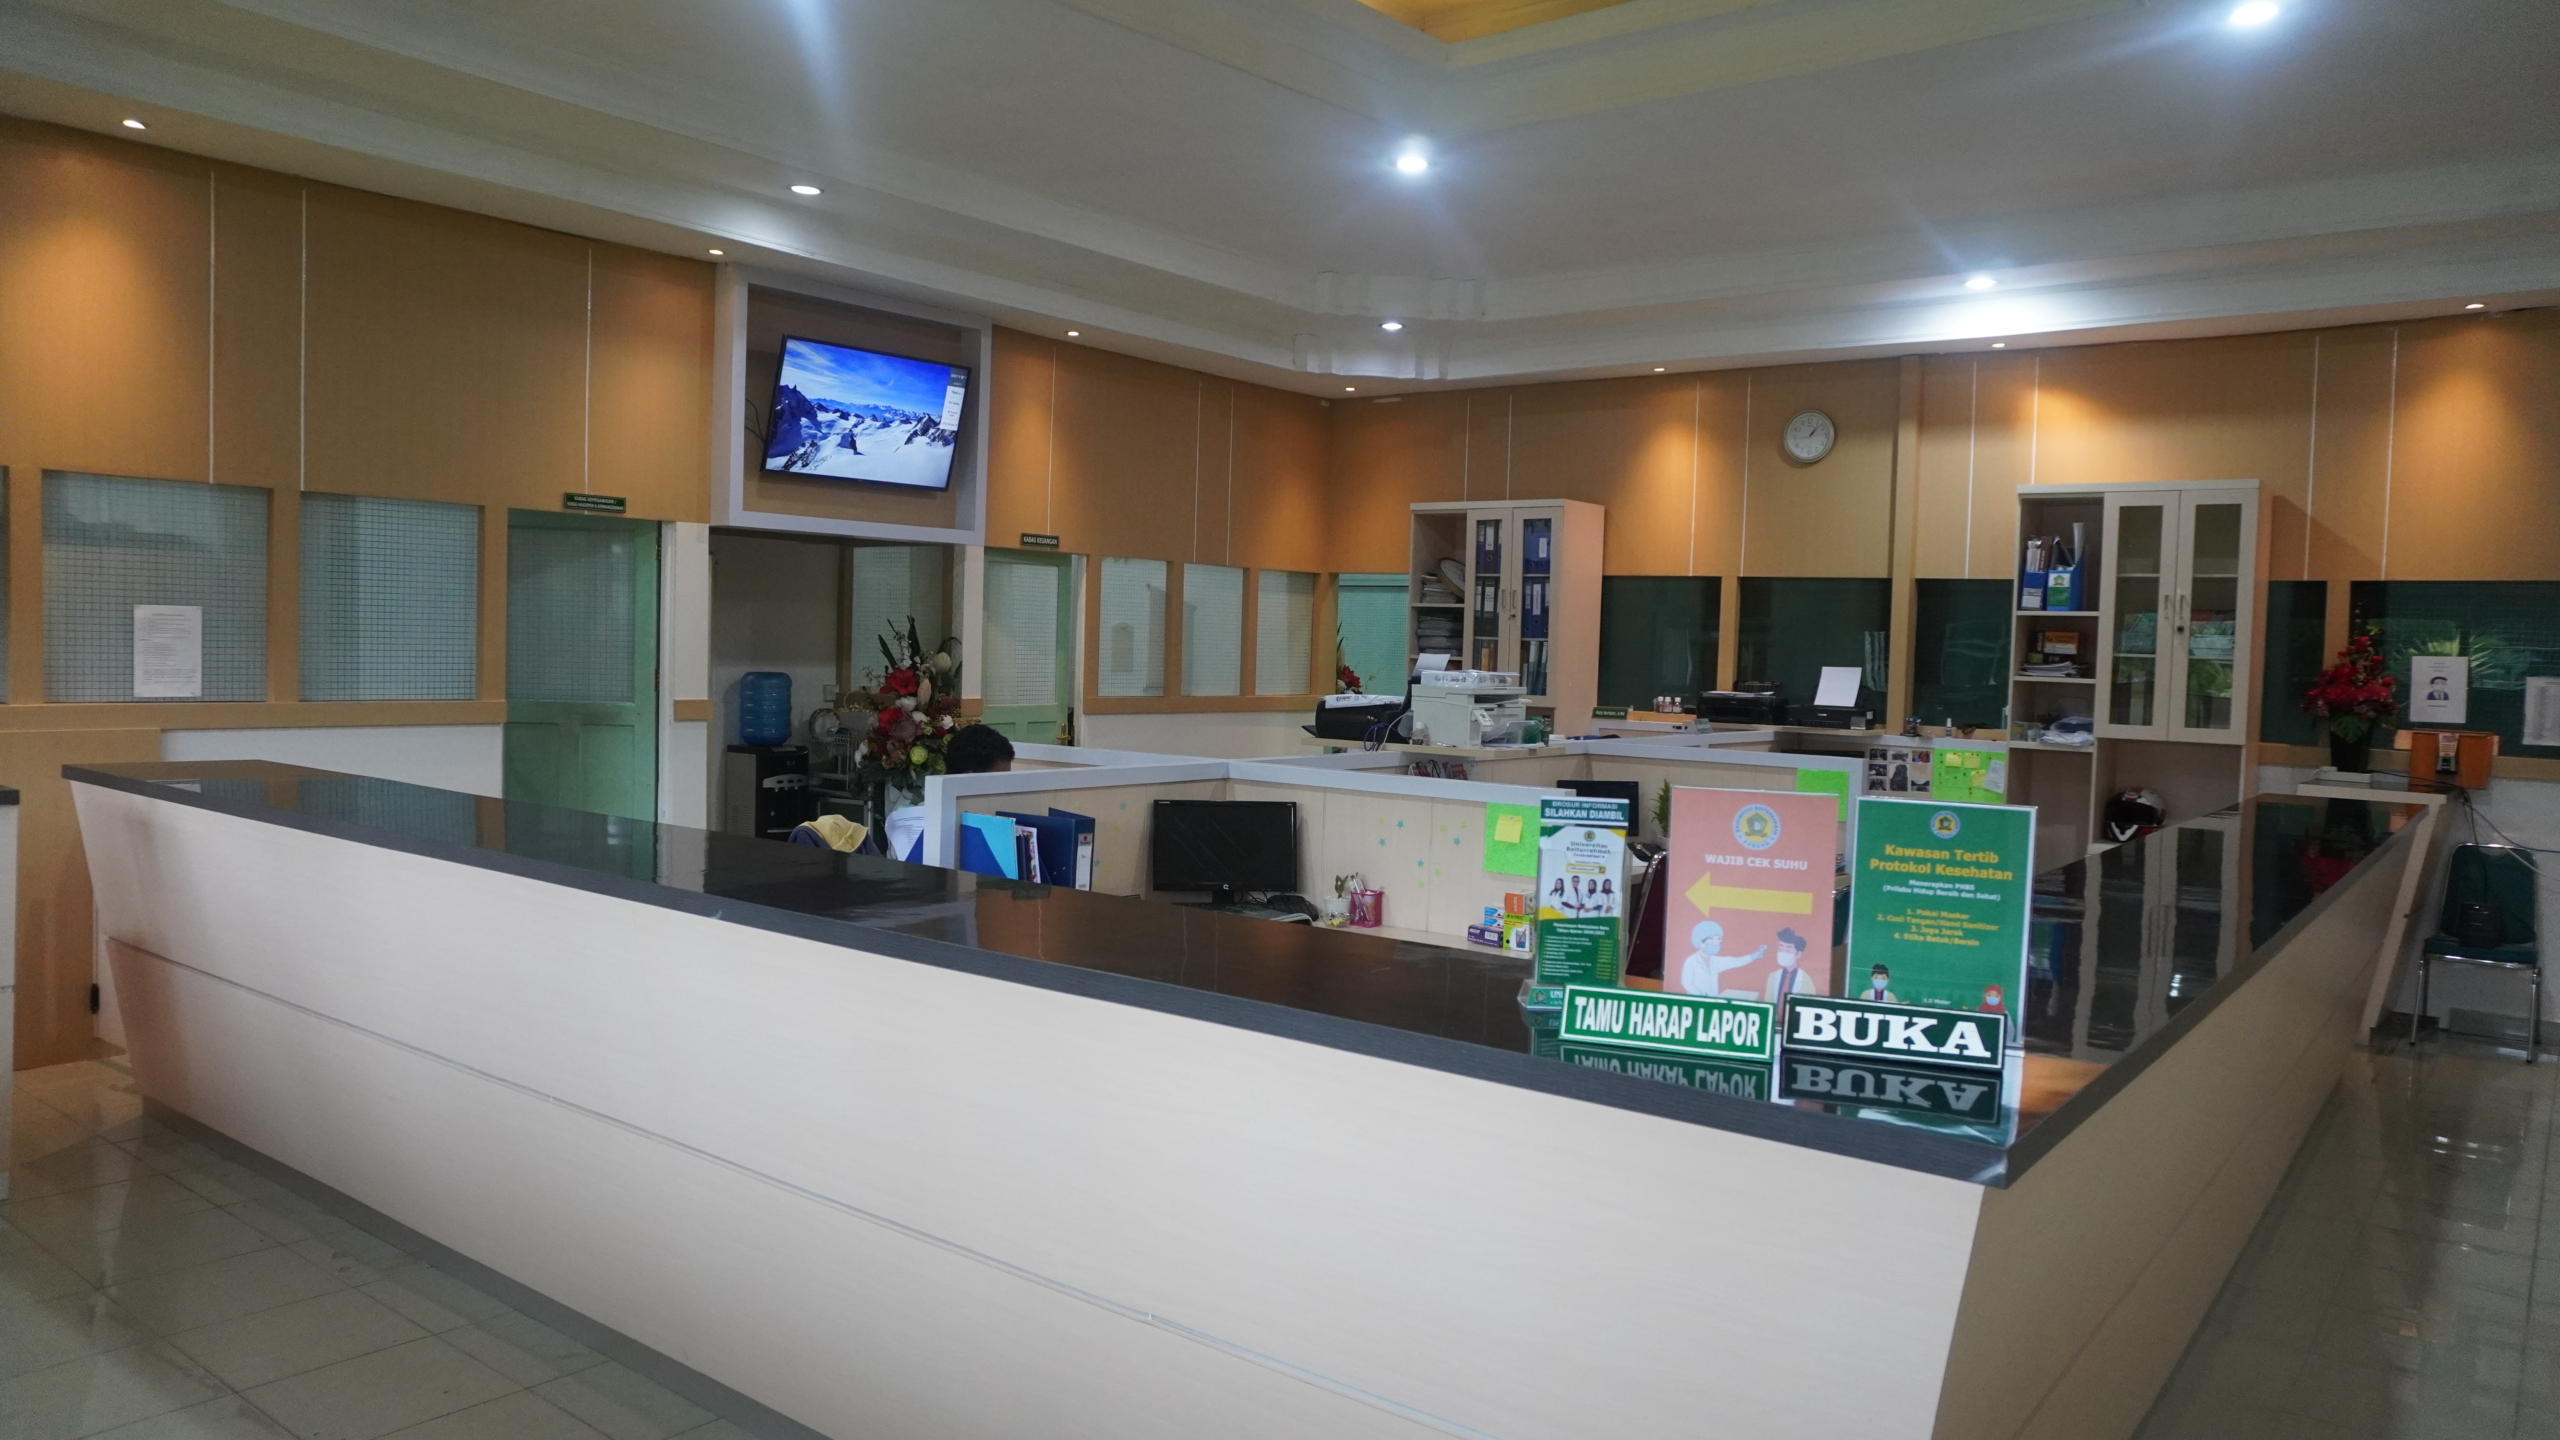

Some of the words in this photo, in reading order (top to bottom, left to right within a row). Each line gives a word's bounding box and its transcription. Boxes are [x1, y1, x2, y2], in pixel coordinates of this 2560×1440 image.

[1545, 808, 1587, 819] SILAHKAN
[1589, 809, 1624, 820] DIAMBIL
[1581, 802, 1618, 810] INFORMASI
[1885, 844, 1950, 859] Kawasan
[1954, 849, 1999, 863] Tertib
[1705, 854, 1744, 866] WAJIB
[1747, 857, 1770, 868] CEK
[1774, 859, 1808, 871] SUHU
[1870, 859, 1931, 874] Protokol
[1936, 864, 2013, 880] Kesehatan
[1909, 879, 1953, 890] Menerapkan
[1961, 891, 1975, 899] dan
[1574, 996, 1625, 1034] TAMU
[1628, 1001, 1693, 1040] HARAP
[1697, 1008, 1760, 1047] LAPOR
[1793, 1005, 1991, 1058] BUKA
